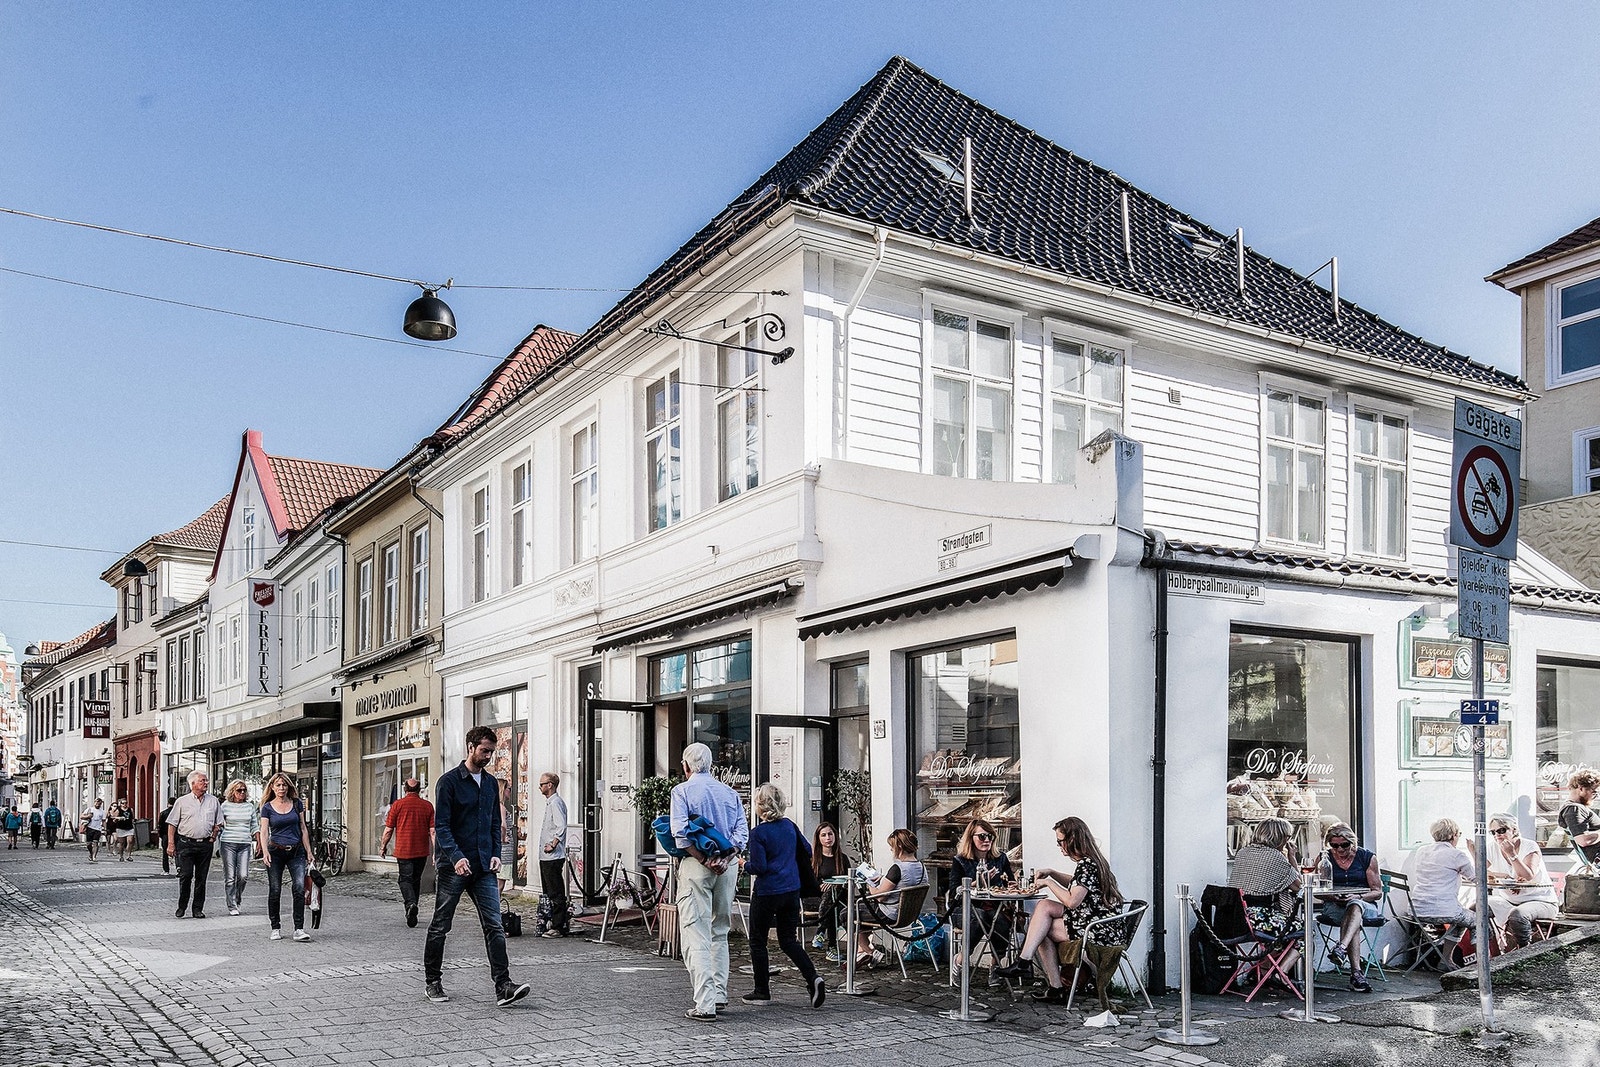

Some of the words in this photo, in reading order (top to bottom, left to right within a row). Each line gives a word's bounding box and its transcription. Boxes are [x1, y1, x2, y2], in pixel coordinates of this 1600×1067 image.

[1466, 406, 1511, 440] Gågate
[942, 530, 984, 552] Strandgaten
[1461, 556, 1488, 573] Gjelder
[1491, 562, 1507, 577] ikke
[1168, 573, 1260, 599] Holbergsallmenningen
[258, 610, 270, 694] FRETEX
[1420, 645, 1454, 657] Pizzeria
[84, 702, 110, 711] Vinni
[355, 693, 379, 717] more
[380, 683, 417, 710] woman
[1462, 701, 1471, 712] 2
[1484, 701, 1490, 712] 1
[1478, 715, 1487, 725] 4
[928, 755, 954, 779] Da
[957, 753, 1007, 785] Stefano
[1244, 747, 1277, 774] Da
[1280, 749, 1335, 782] Stefano
